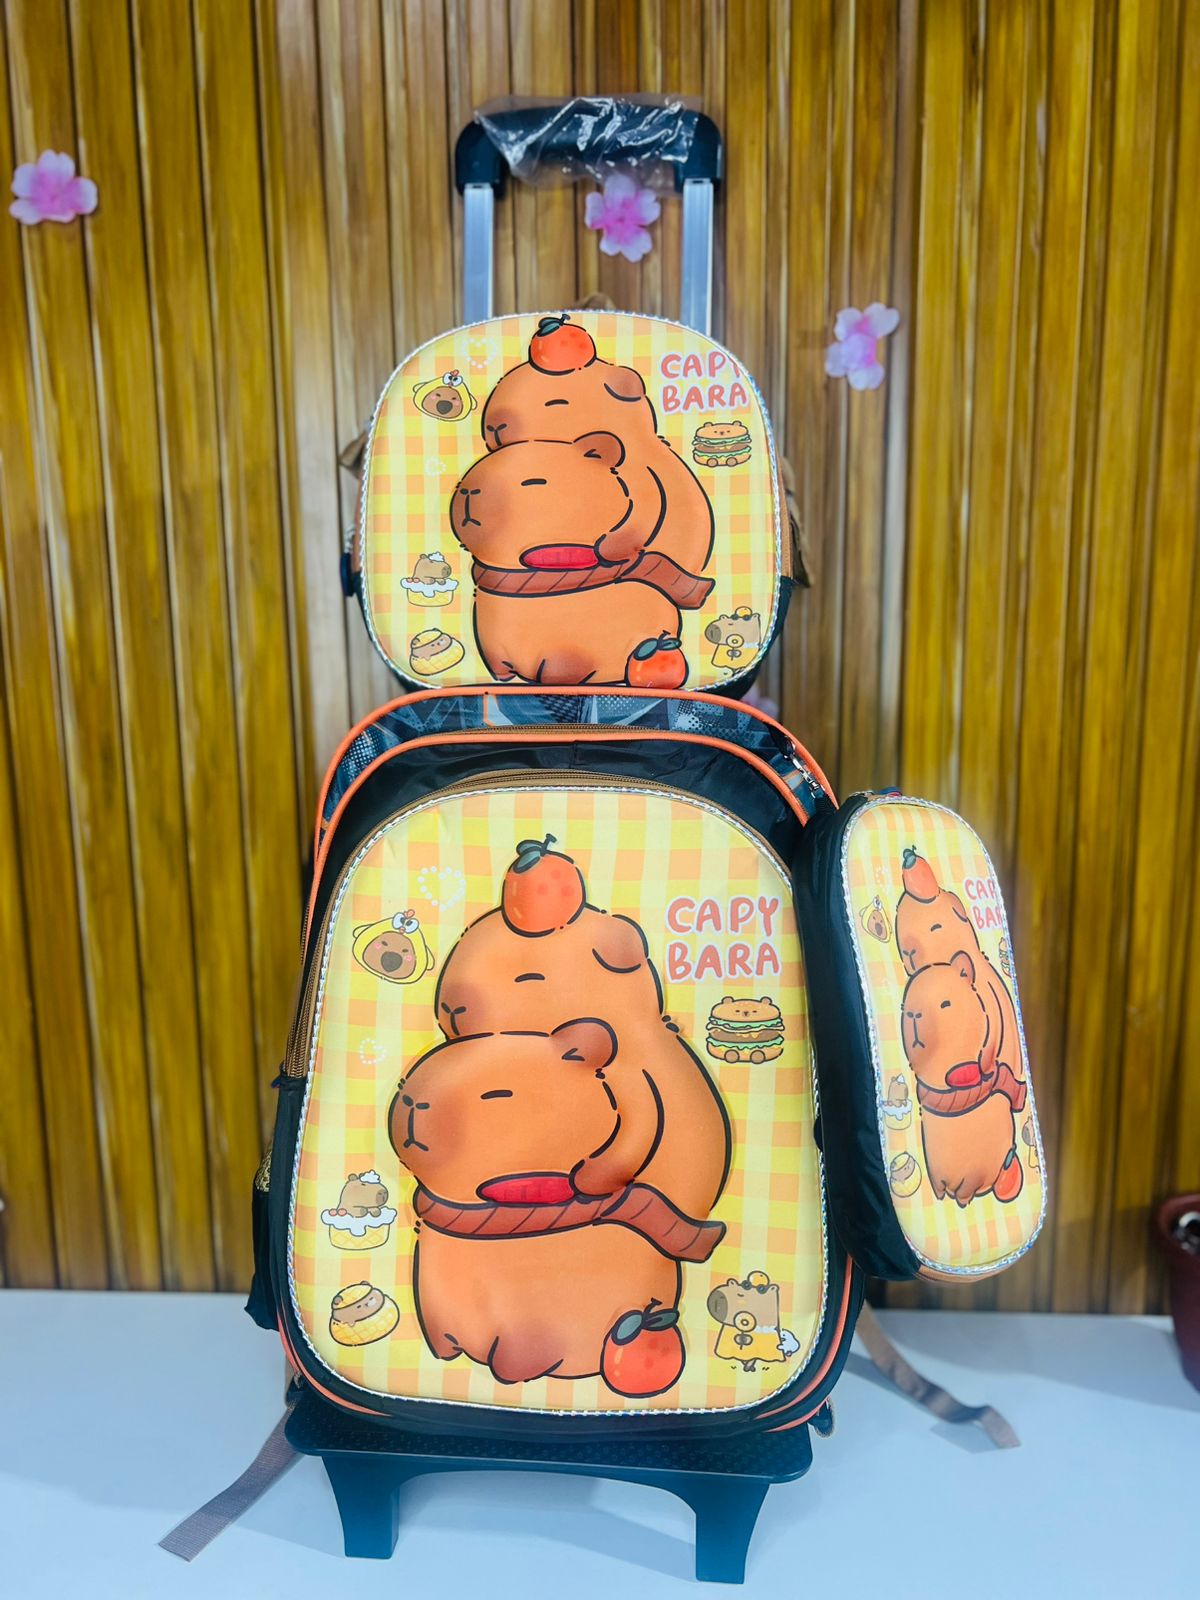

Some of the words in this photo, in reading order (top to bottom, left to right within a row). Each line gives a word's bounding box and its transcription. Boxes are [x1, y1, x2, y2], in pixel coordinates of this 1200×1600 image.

[662, 382, 747, 412] BARA
[667, 896, 779, 936] CAPY
[668, 942, 779, 980] BARA
